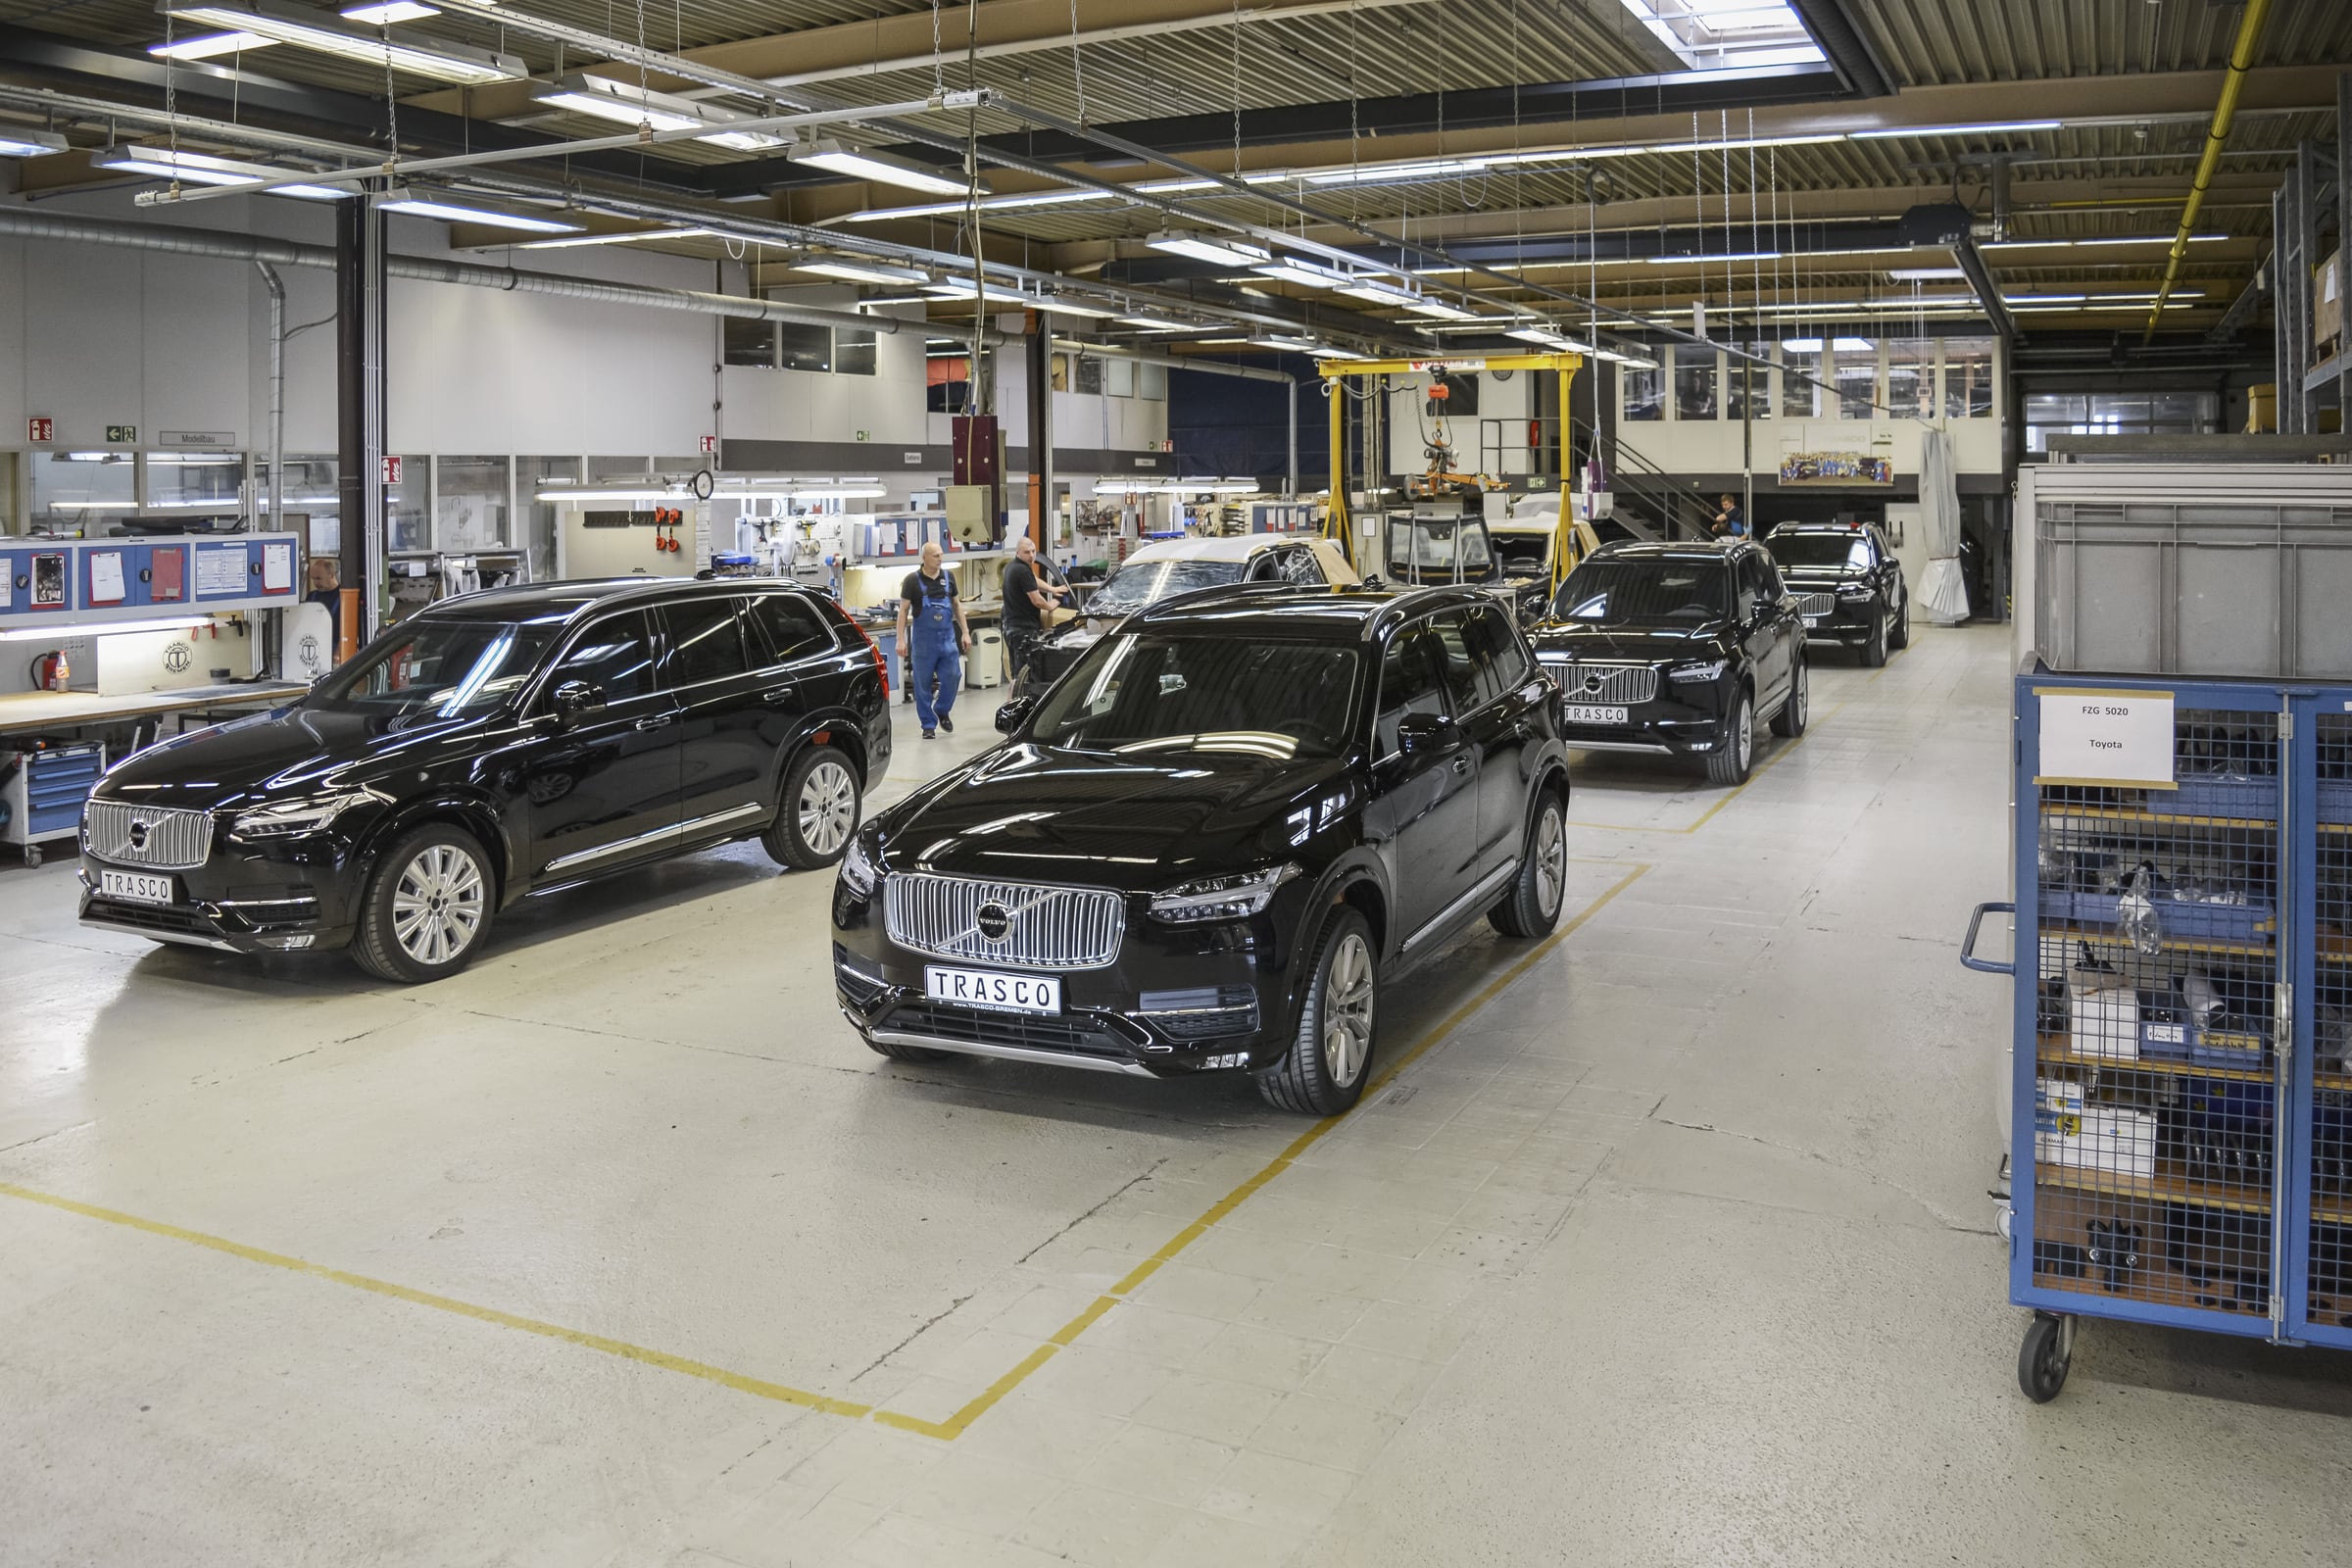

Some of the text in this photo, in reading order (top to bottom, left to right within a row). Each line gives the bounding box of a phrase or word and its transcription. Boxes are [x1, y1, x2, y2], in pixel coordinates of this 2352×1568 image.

[181, 434, 216, 444] Modellbau
[165, 642, 189, 654] TRASCO
[165, 661, 190, 673] BREMEN
[1564, 708, 1624, 721] TRASCO
[2082, 706, 2129, 715] FZG 5020
[2089, 739, 2123, 750] Toyota
[105, 873, 169, 899] TRASCO
[935, 972, 1050, 1006] TRASCO
[953, 1002, 1032, 1015] www.TRASCO-BREMEN.de
